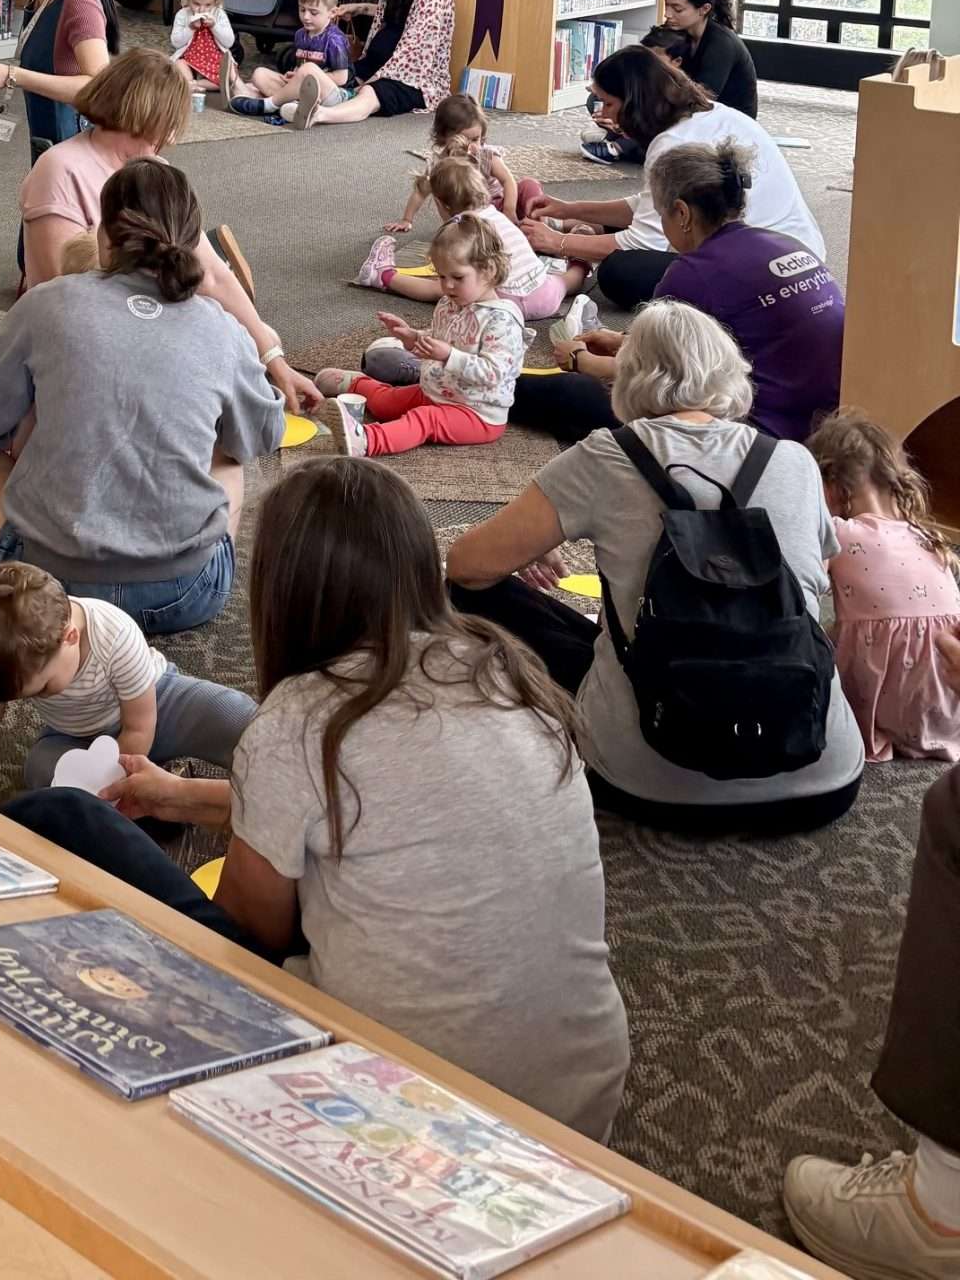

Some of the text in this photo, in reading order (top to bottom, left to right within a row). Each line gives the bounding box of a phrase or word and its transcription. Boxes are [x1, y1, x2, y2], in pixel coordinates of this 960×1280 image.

[758, 293, 776, 307] is
[775, 254, 817, 275] Action
[34, 986, 166, 1058] Winter
[211, 1096, 456, 1243] MONSTERS
[258, 1101, 458, 1220] LOVE
